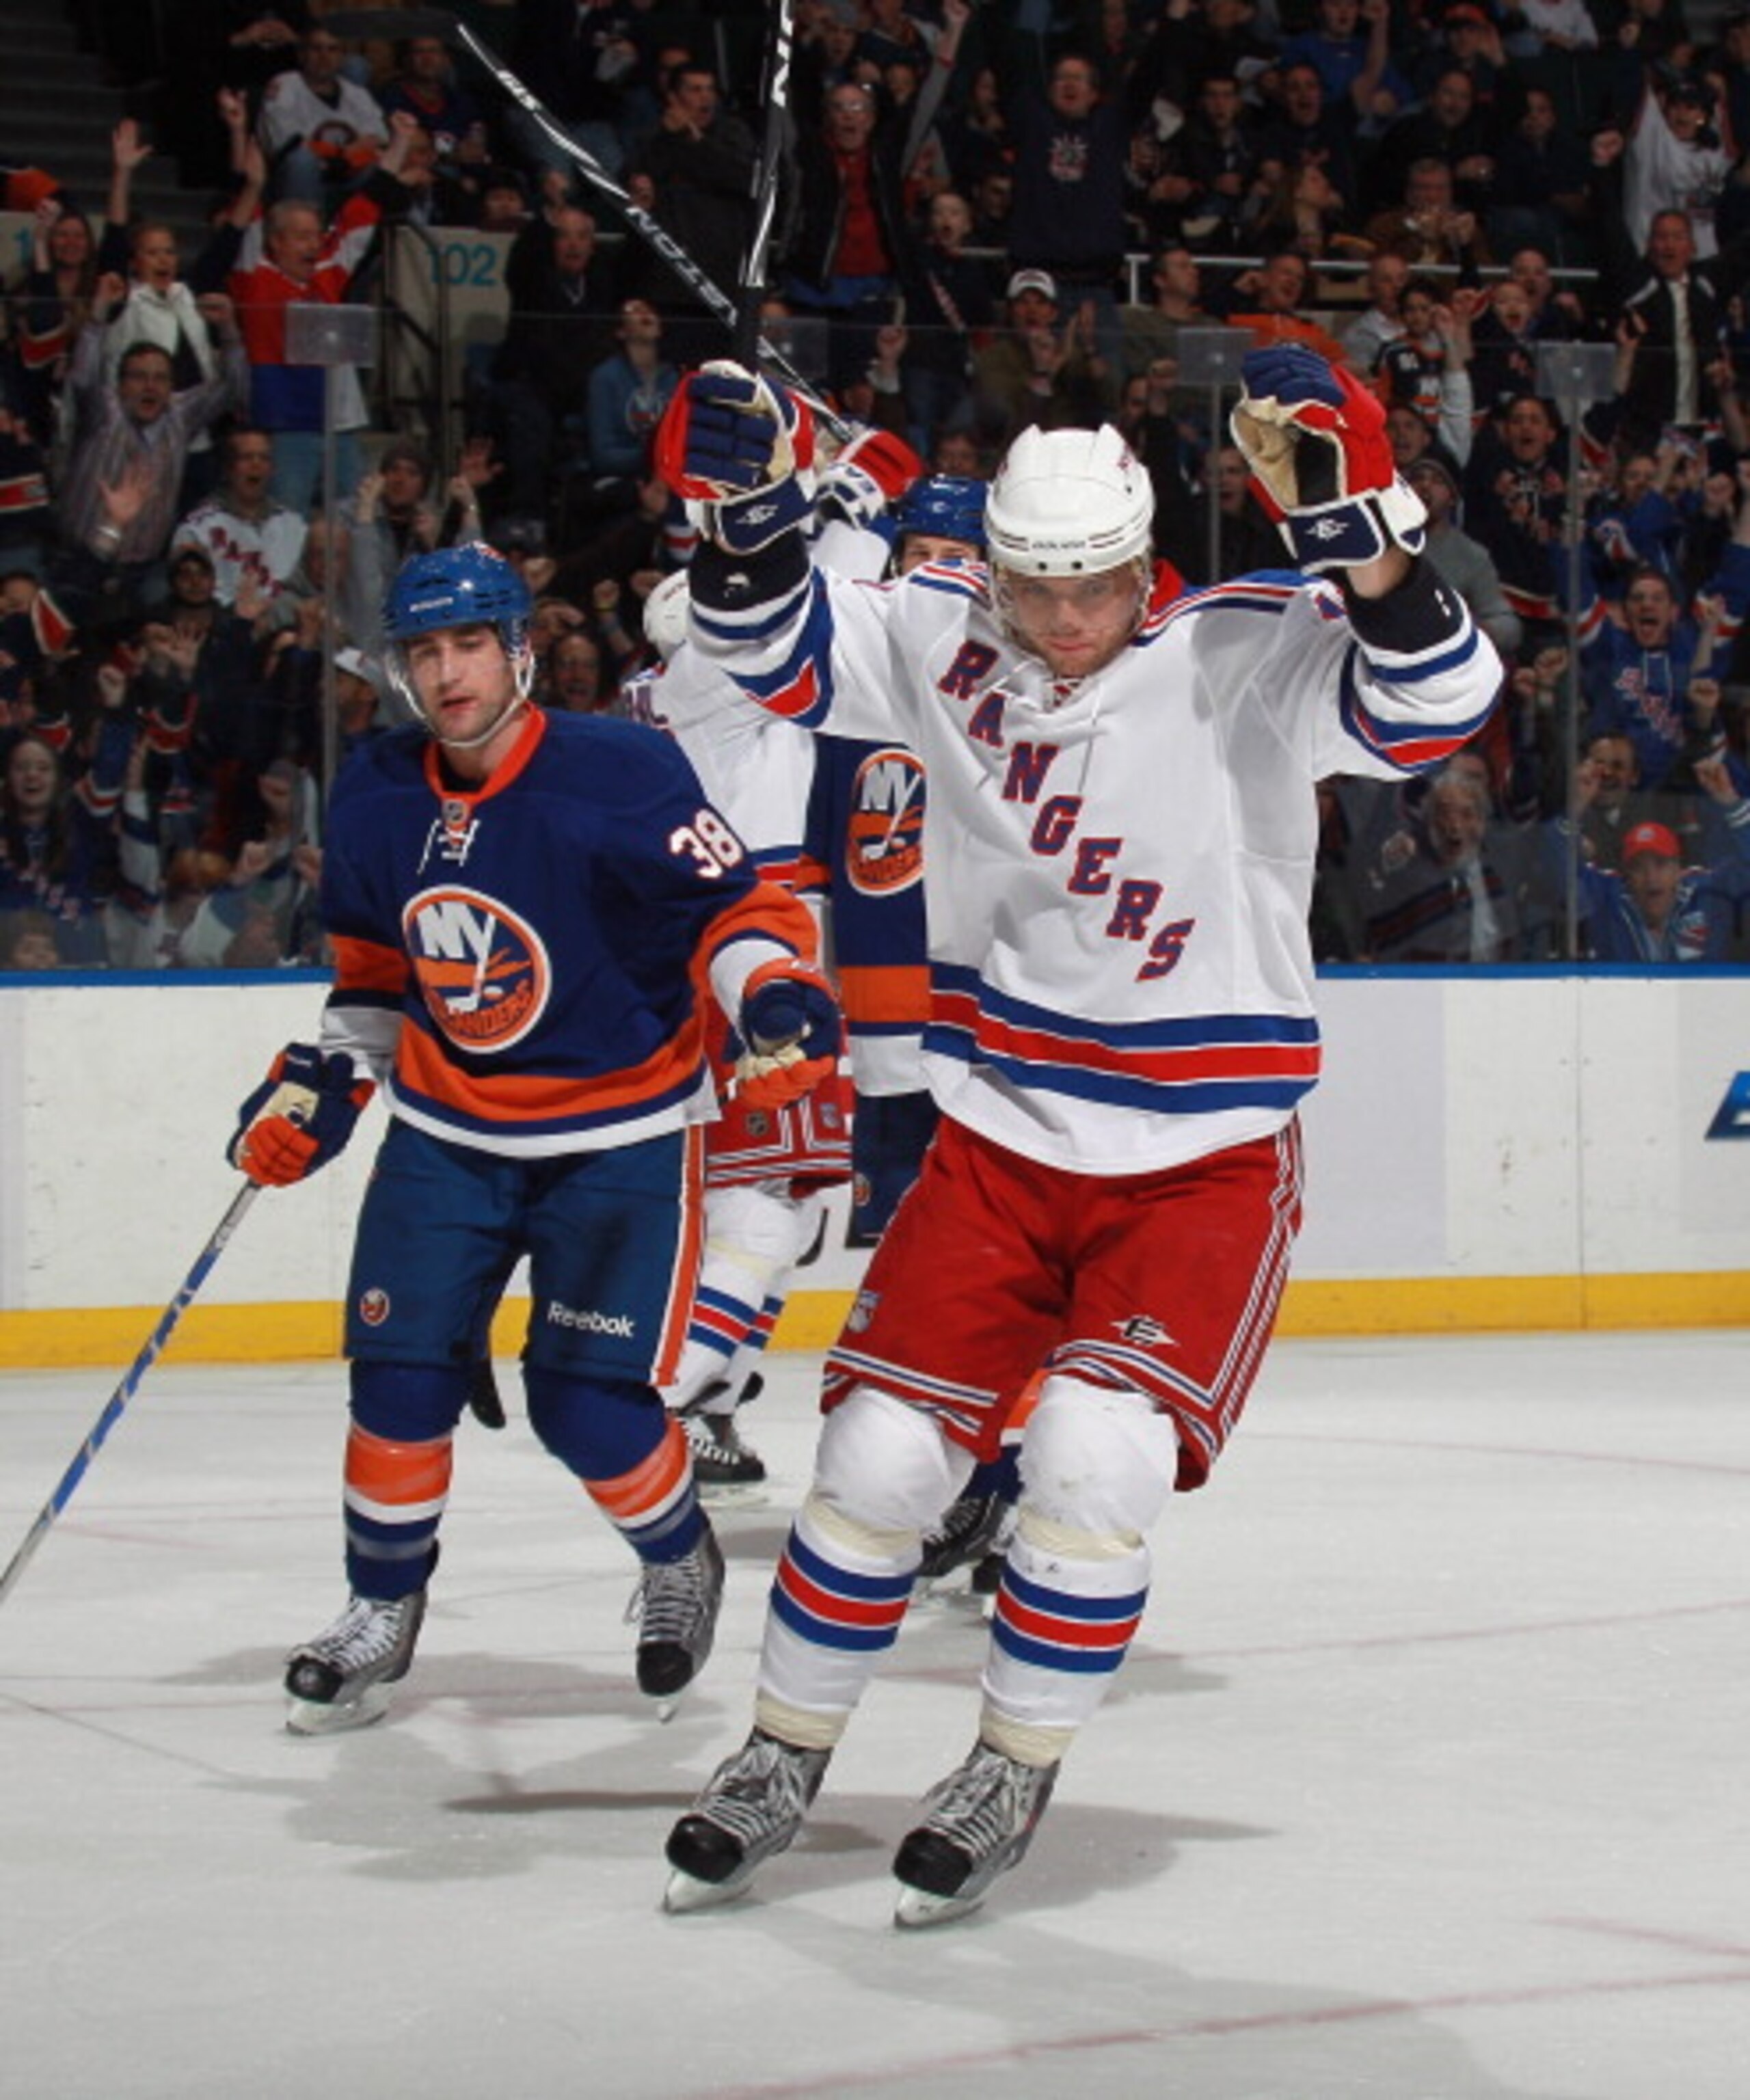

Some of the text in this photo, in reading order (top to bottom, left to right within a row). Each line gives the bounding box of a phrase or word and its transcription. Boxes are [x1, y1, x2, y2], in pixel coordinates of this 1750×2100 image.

[427, 243, 497, 285] 102
[937, 638, 1196, 982] RANGERS
[670, 809, 742, 878] 38
[417, 900, 496, 965] NY
[548, 1300, 636, 1338] Reebok
